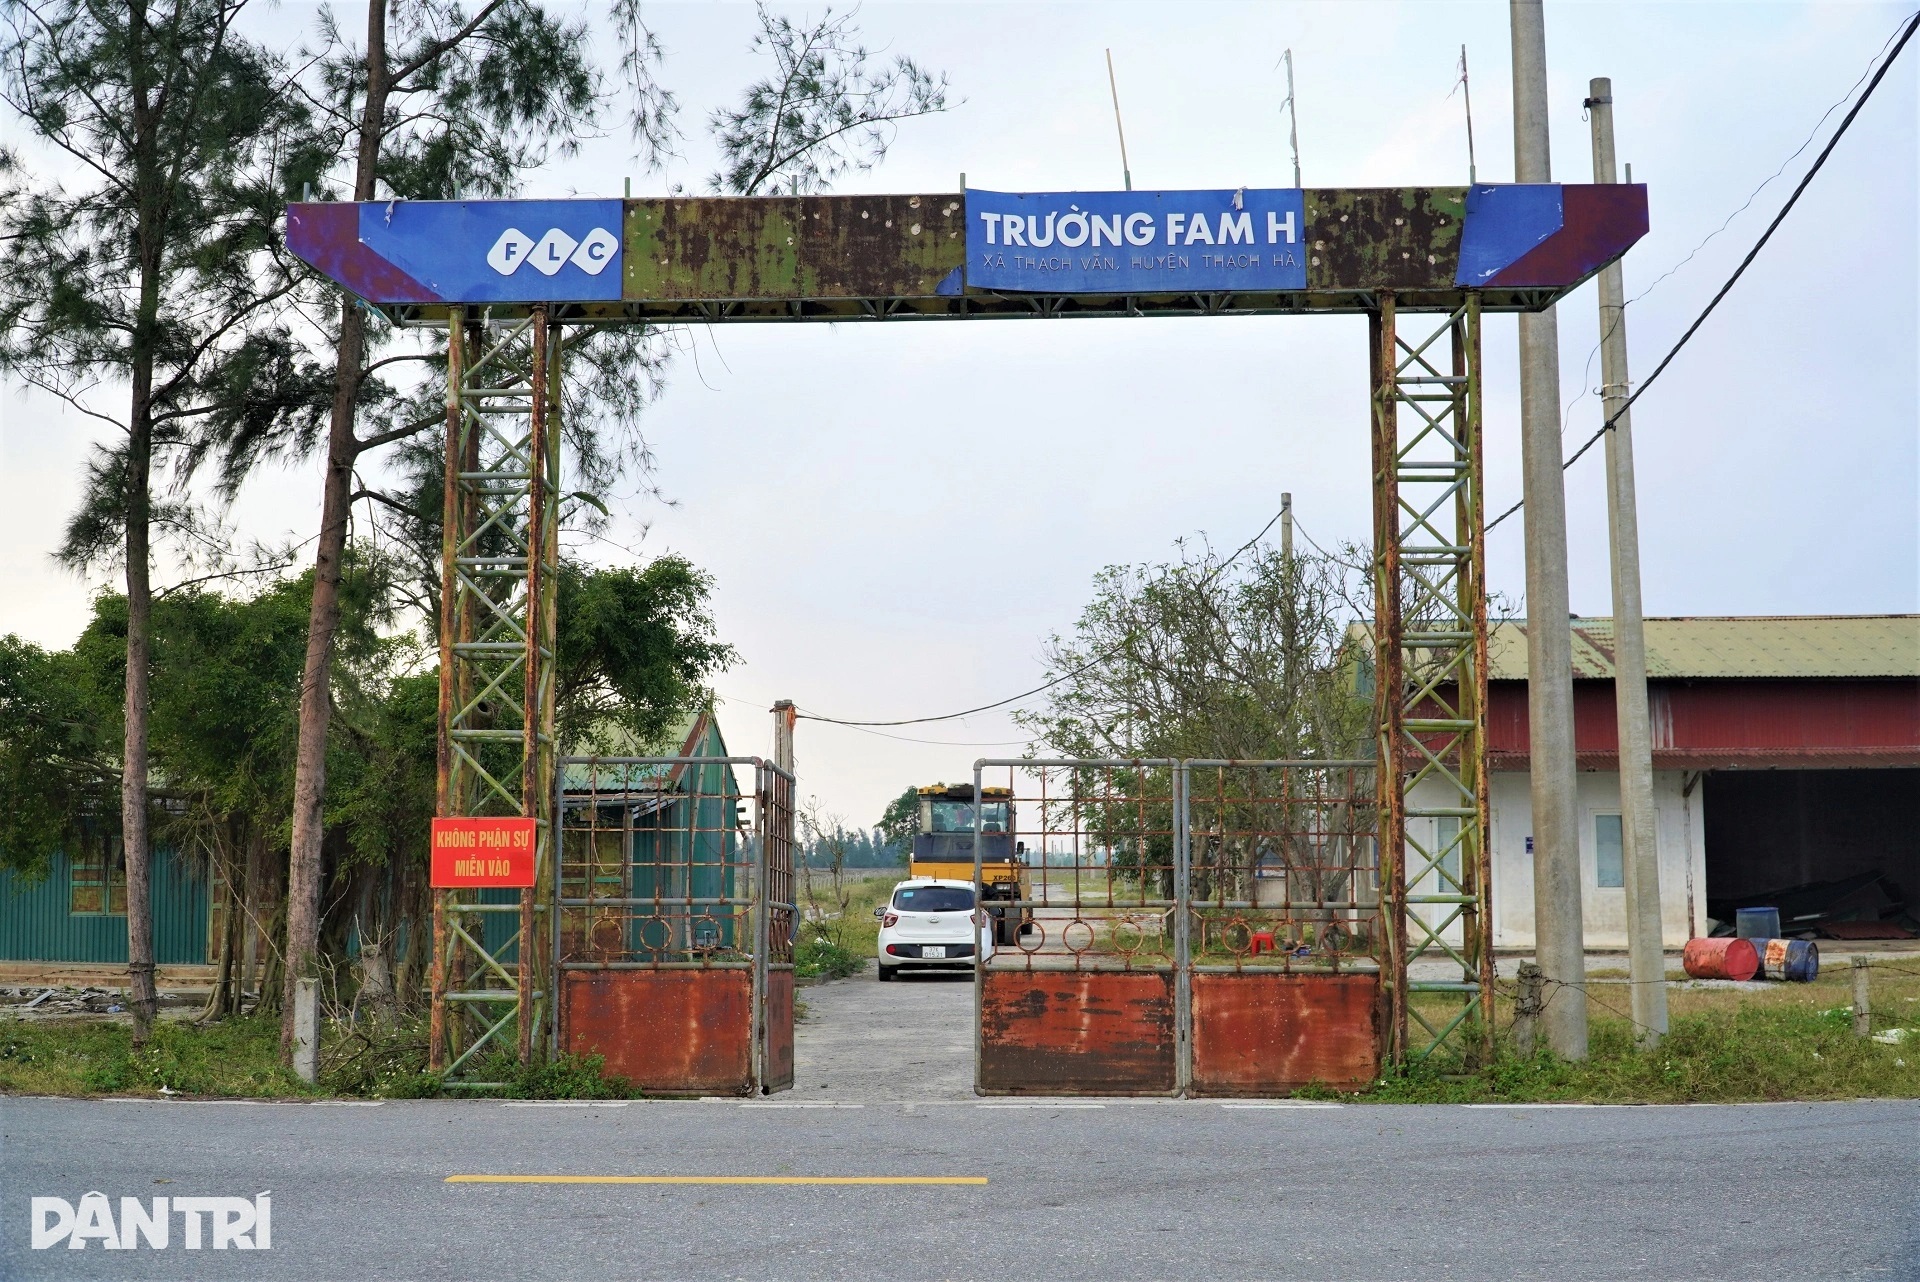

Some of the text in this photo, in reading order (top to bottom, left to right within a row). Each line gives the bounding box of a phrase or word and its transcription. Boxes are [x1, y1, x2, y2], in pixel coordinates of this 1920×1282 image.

[980, 204, 1296, 248] TRƯỜNG FAM H
[505, 242, 605, 261] FLC
[983, 252, 1006, 269] XÃ
[1014, 256, 1073, 273] THẠCH
[1131, 252, 1190, 272] HUYỆN
[1202, 254, 1261, 271] THẠCH
[436, 828, 531, 851] KHÔNG PHẬN SỰ
[455, 853, 511, 877] MIỄN VÀO
